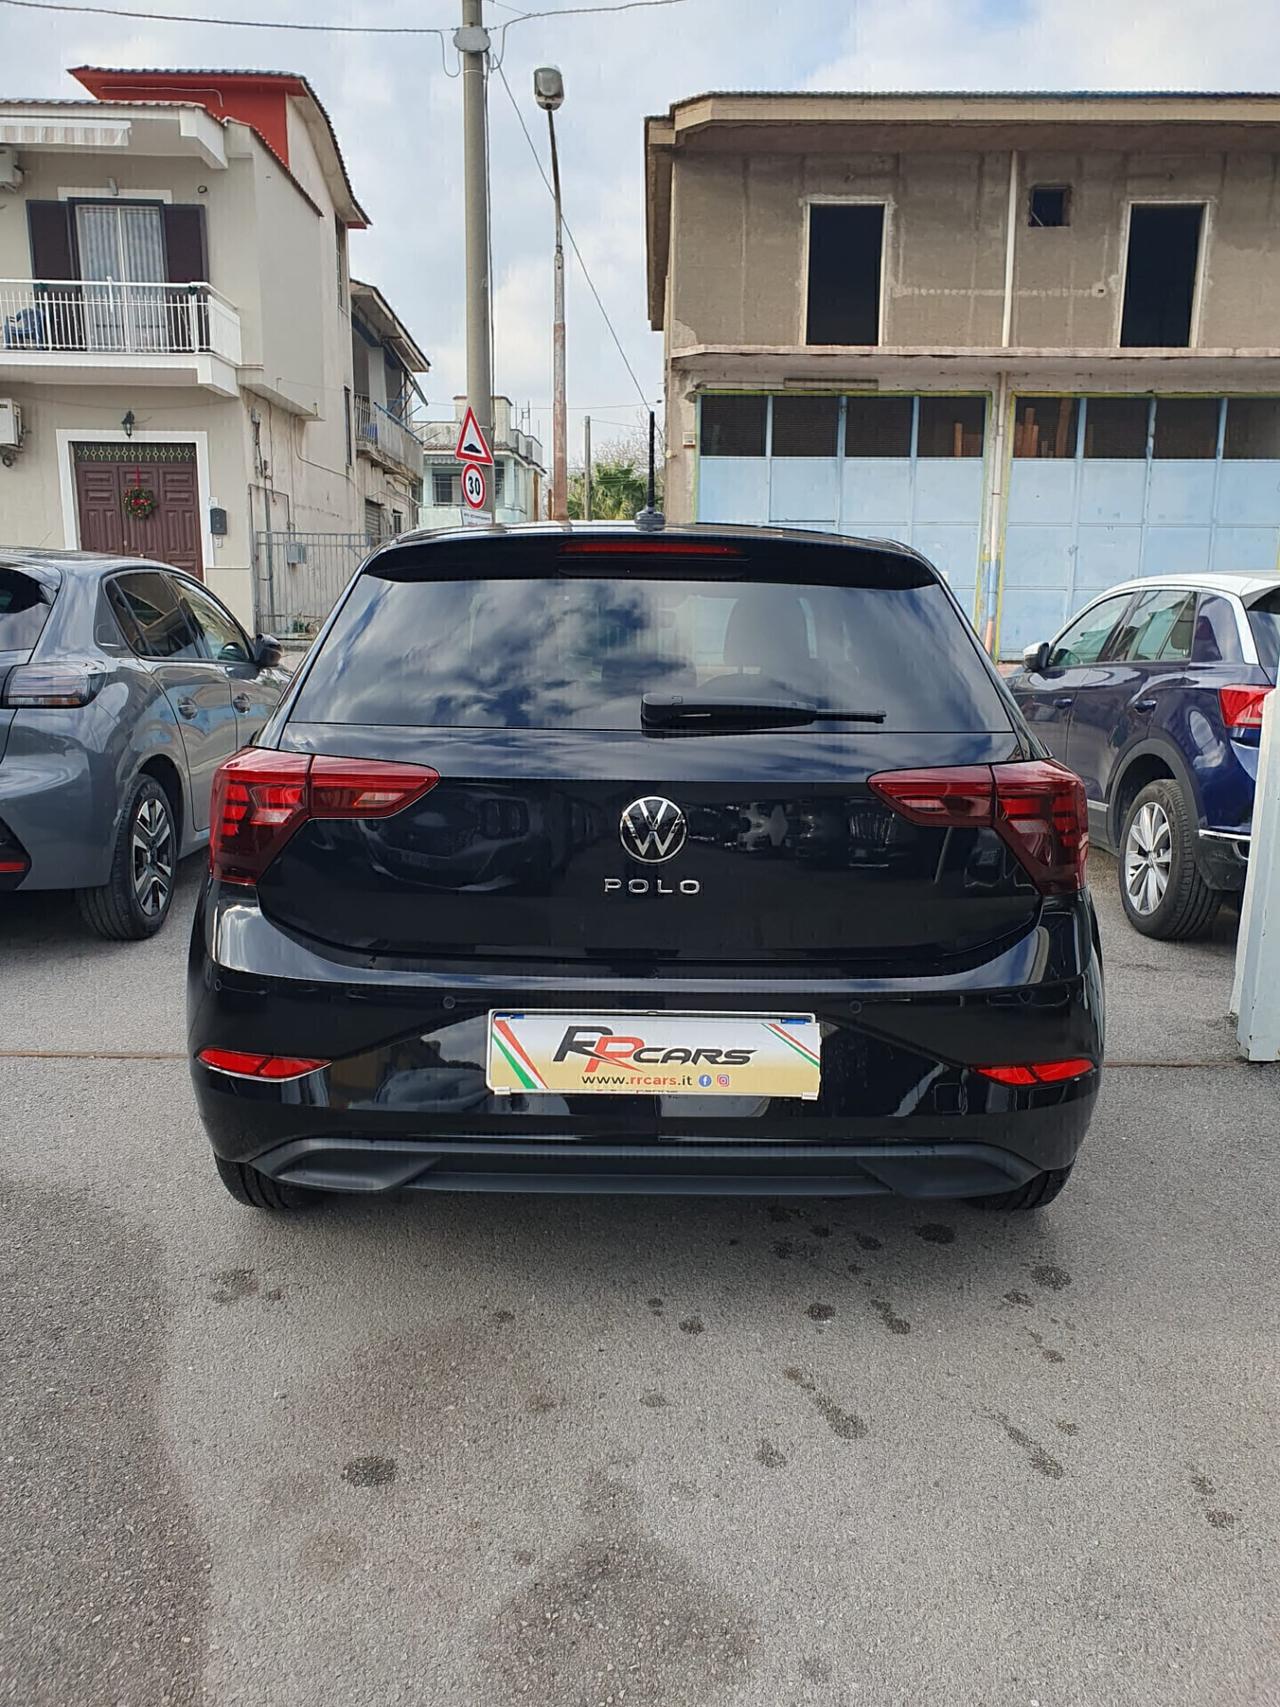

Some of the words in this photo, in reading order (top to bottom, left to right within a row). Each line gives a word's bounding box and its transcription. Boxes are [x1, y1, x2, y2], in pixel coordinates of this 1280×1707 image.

[468, 476, 481, 496] 30
[604, 878, 701, 894] POLO
[581, 1074, 693, 1087] www.rrcars.it
